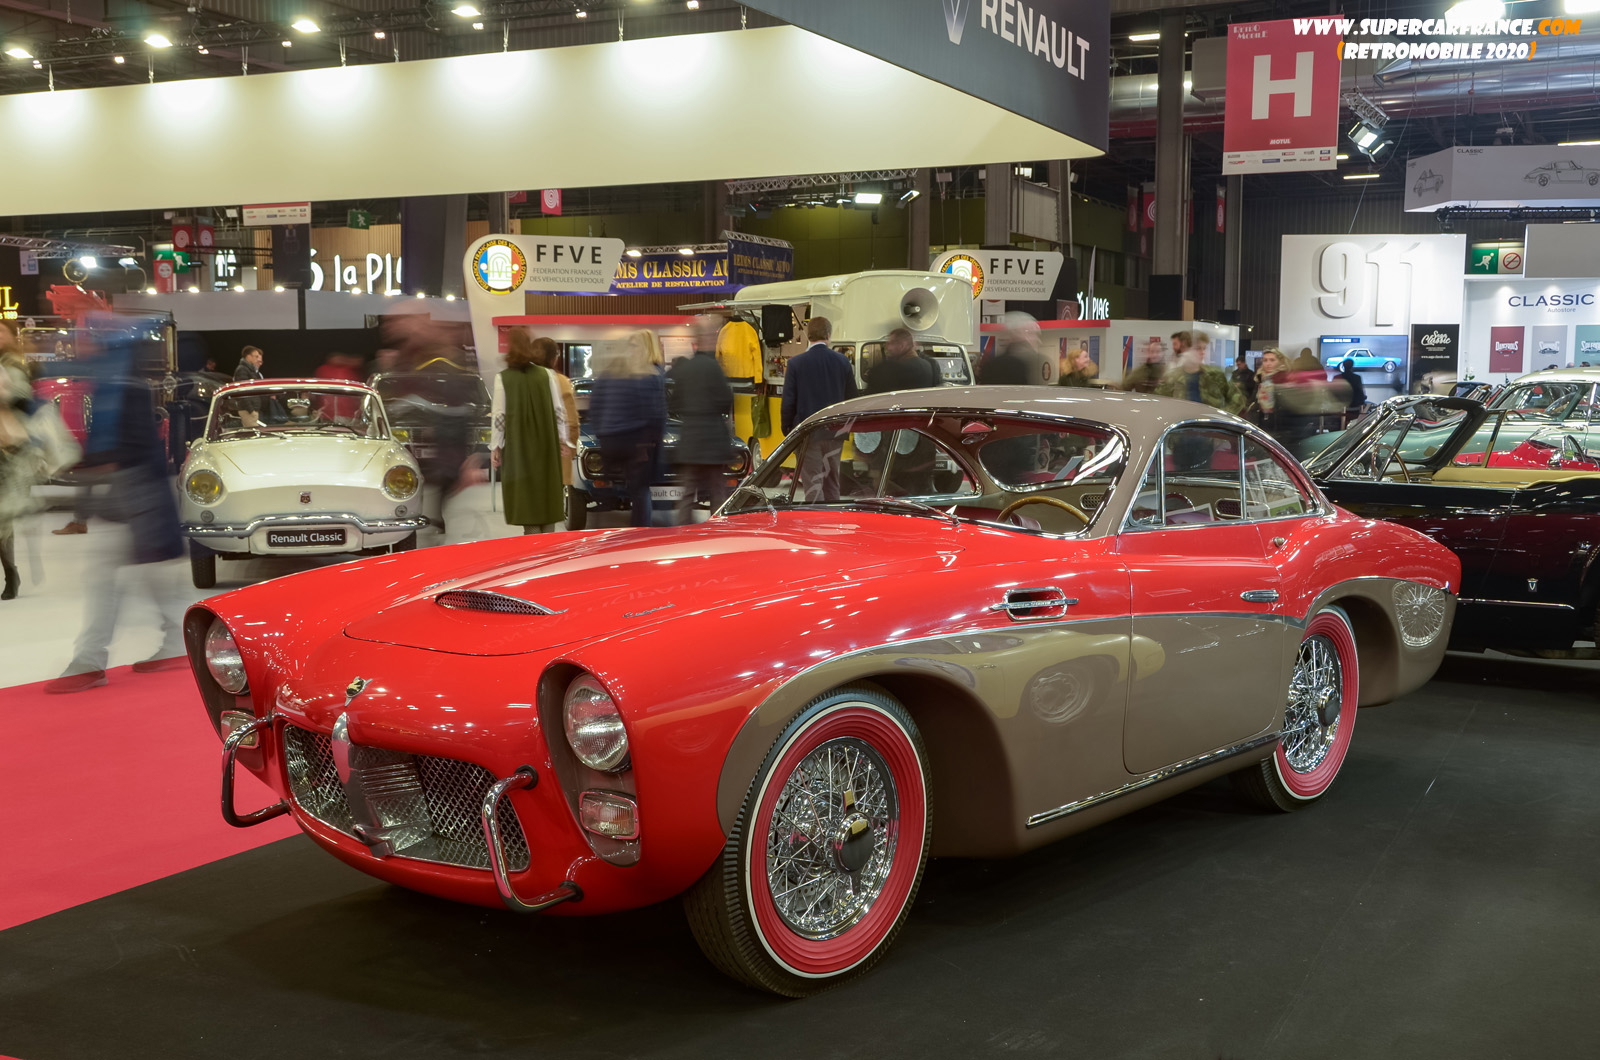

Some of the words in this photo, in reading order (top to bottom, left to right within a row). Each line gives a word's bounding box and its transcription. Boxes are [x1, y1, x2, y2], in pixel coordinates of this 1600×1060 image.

[981, 0, 1090, 81] RENAULT
[1252, 51, 1314, 120] H
[536, 244, 602, 265] FFVE
[642, 260, 707, 279] CLASSIC
[712, 258, 728, 277] AU
[990, 258, 1045, 275] FFVE
[665, 279, 725, 288] RESTAURATION
[1318, 241, 1433, 331] 911
[1508, 293, 1595, 308] CLASSIC
[270, 533, 308, 543] Renault
[309, 532, 343, 542] Classic
